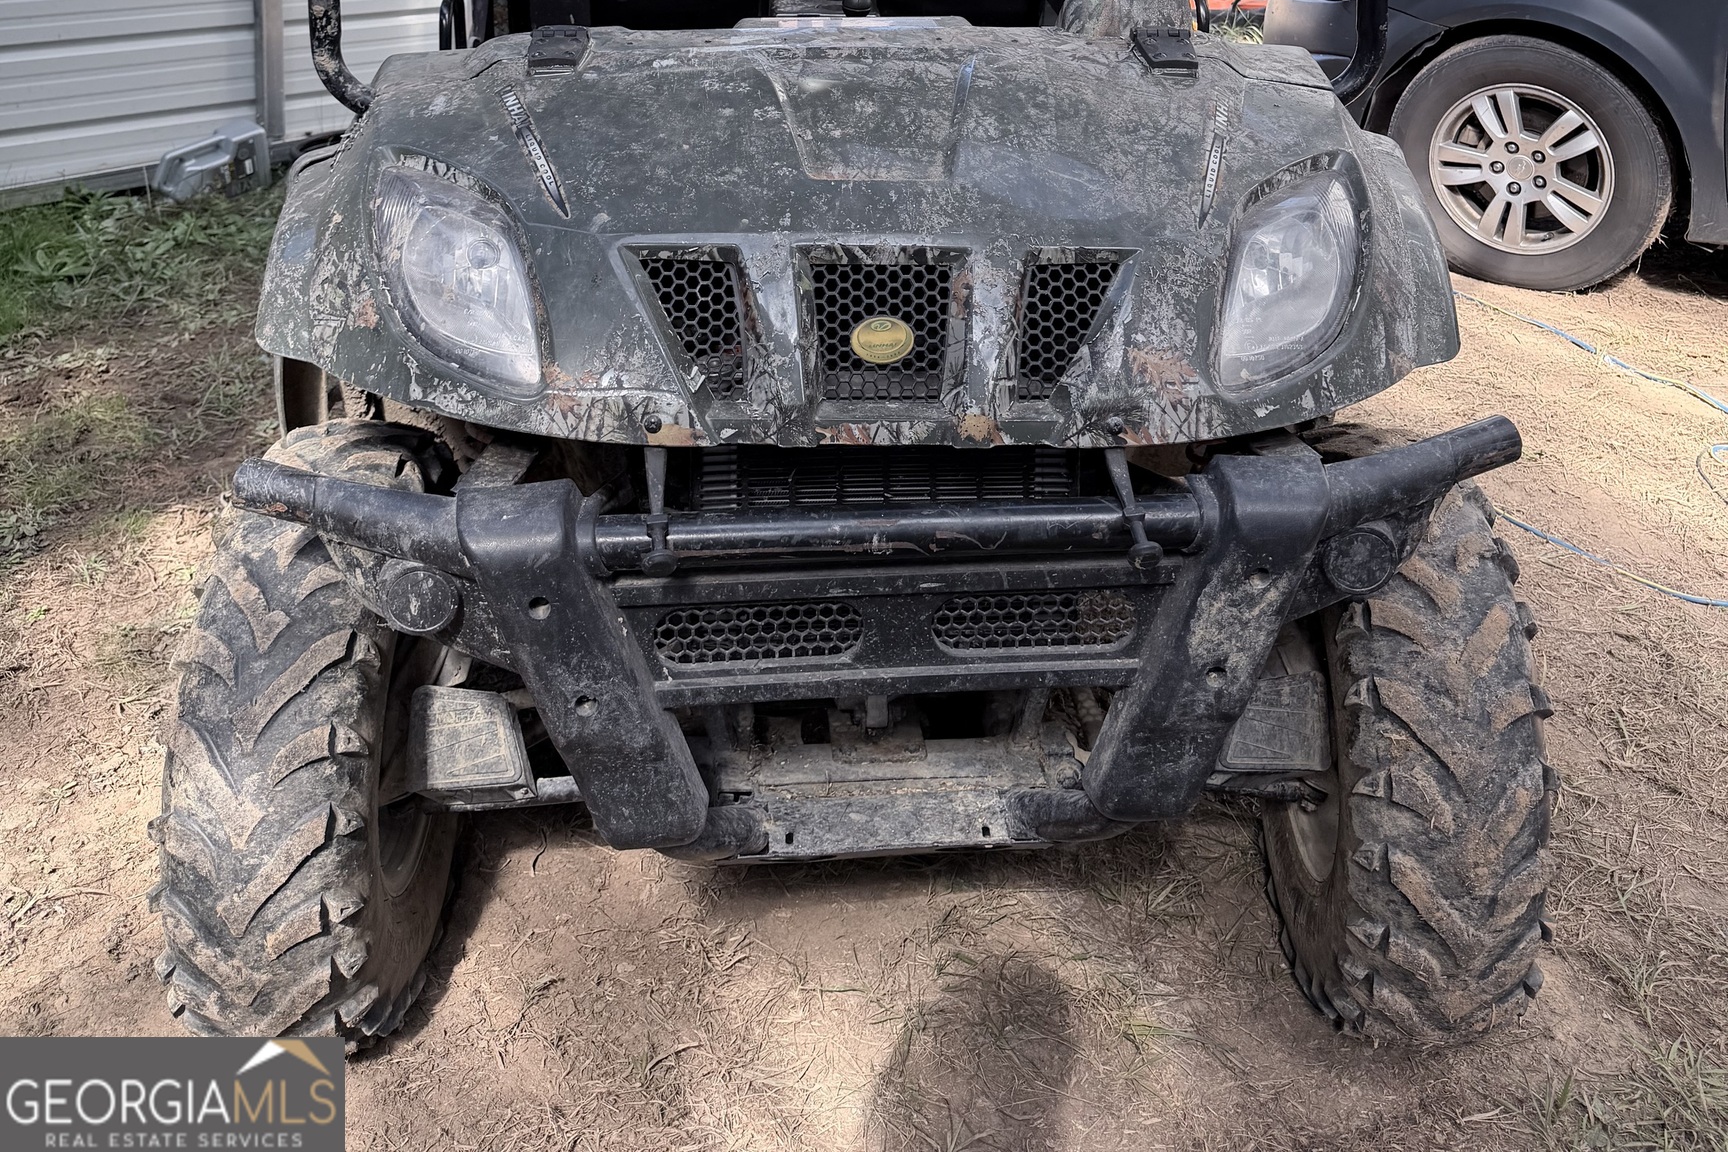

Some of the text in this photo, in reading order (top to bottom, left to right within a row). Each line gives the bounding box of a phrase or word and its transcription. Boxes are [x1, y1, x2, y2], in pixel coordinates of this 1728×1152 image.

[525, 134, 554, 186] LIQUID COOL
[1206, 146, 1220, 198] LIQUID COOL
